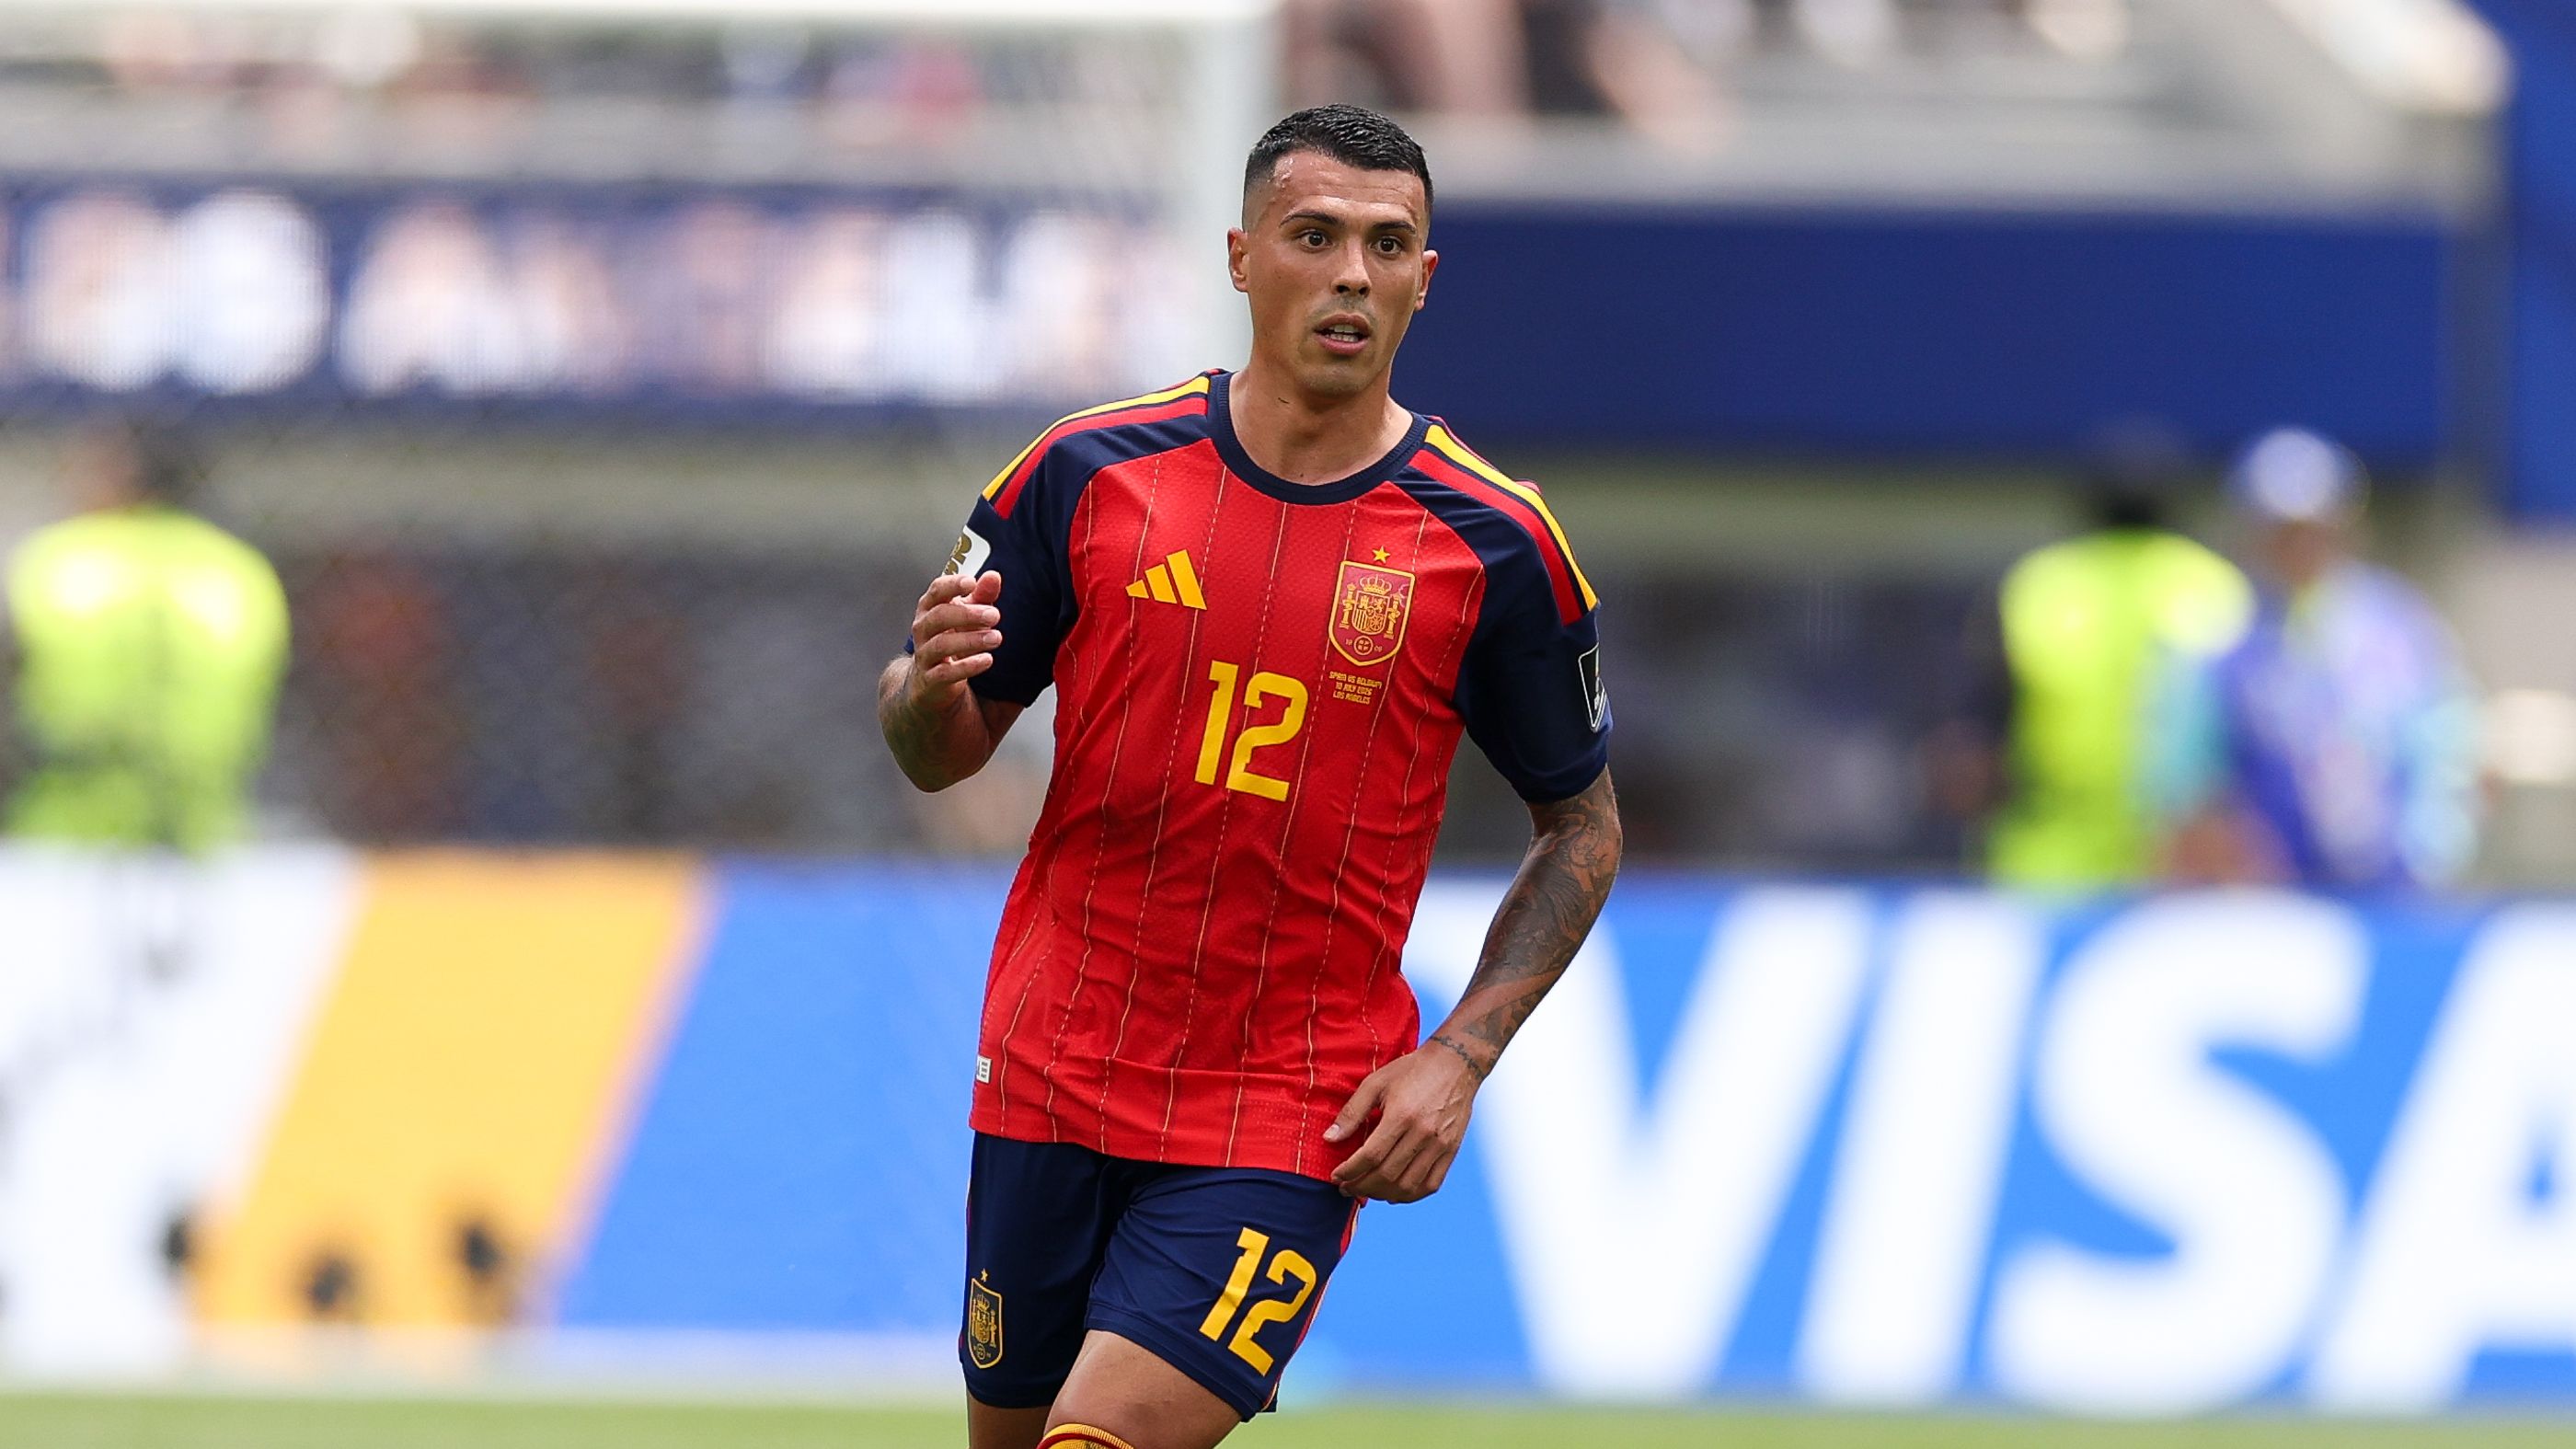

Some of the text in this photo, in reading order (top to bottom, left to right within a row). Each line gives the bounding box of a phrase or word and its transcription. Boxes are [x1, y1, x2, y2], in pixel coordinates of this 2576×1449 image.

[1194, 660, 1308, 802] 12
[1400, 887, 2576, 1414] VISA
[1199, 1226, 1317, 1377] 12
